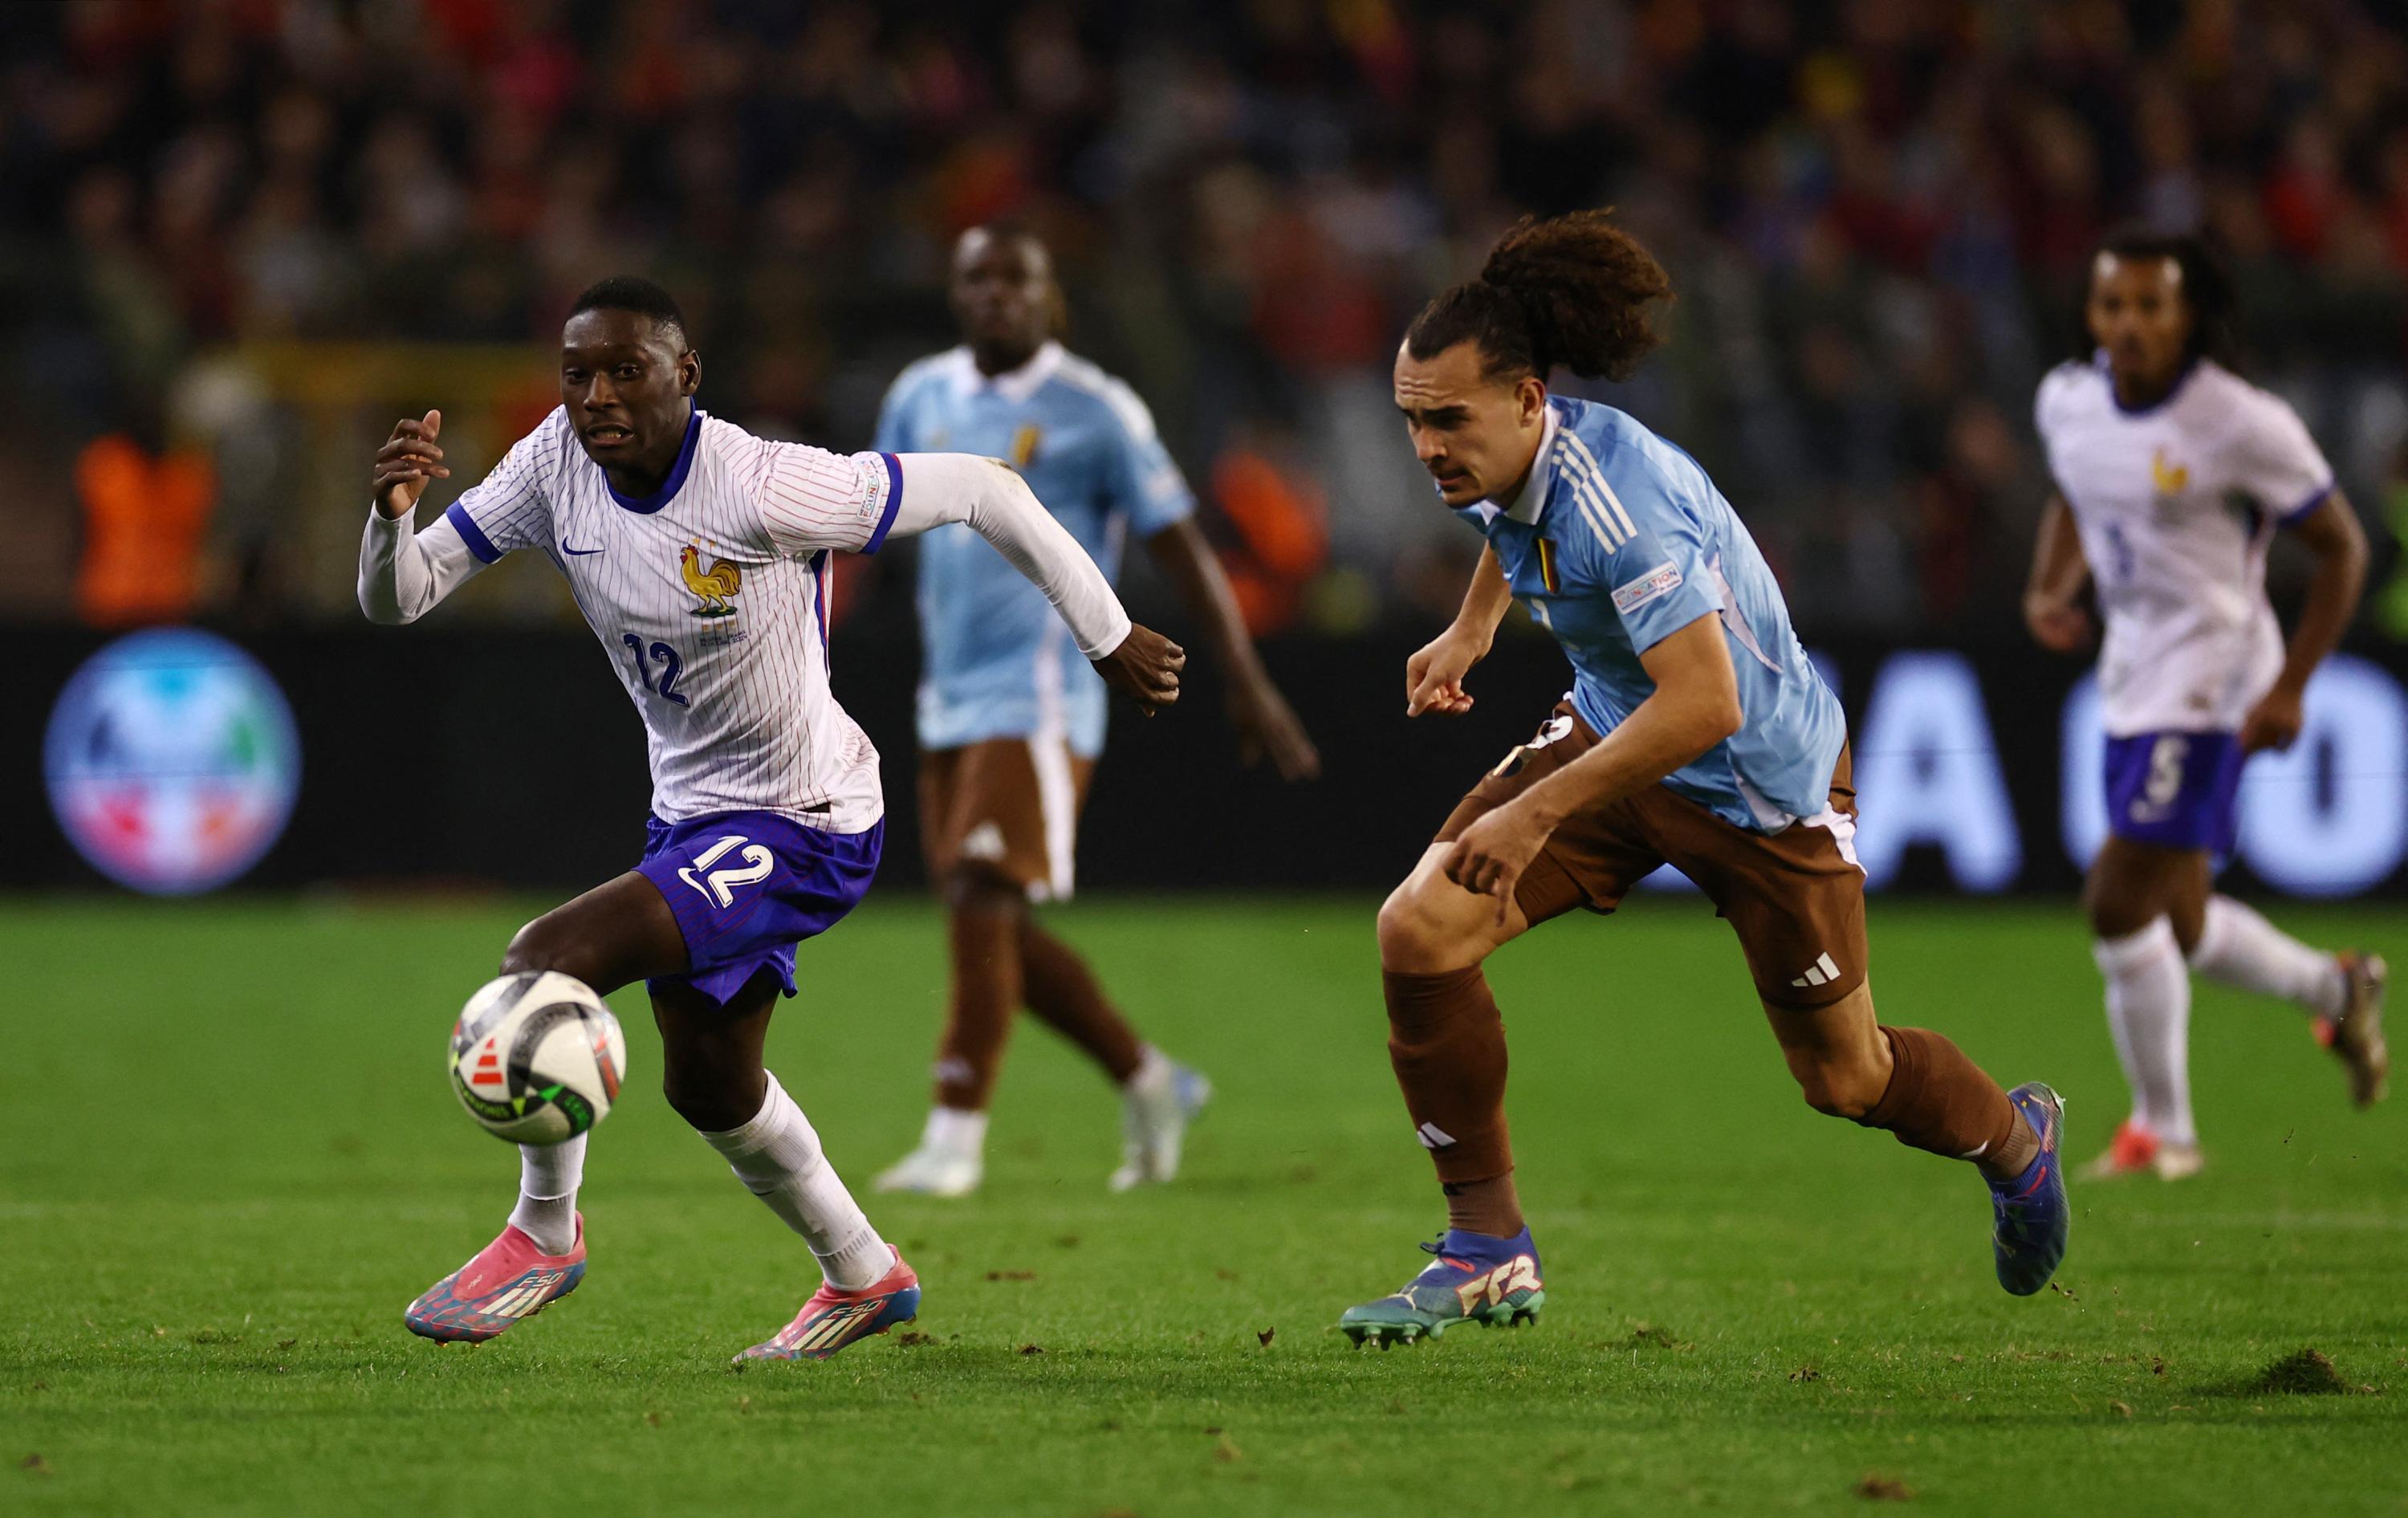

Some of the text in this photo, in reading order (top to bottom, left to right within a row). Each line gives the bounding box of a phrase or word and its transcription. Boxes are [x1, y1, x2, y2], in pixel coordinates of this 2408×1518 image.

[623, 633, 690, 708] 12
[2144, 736, 2193, 806] 5
[693, 835, 774, 909] 12
[518, 1272, 564, 1288] F50
[827, 1300, 883, 1318] F50
